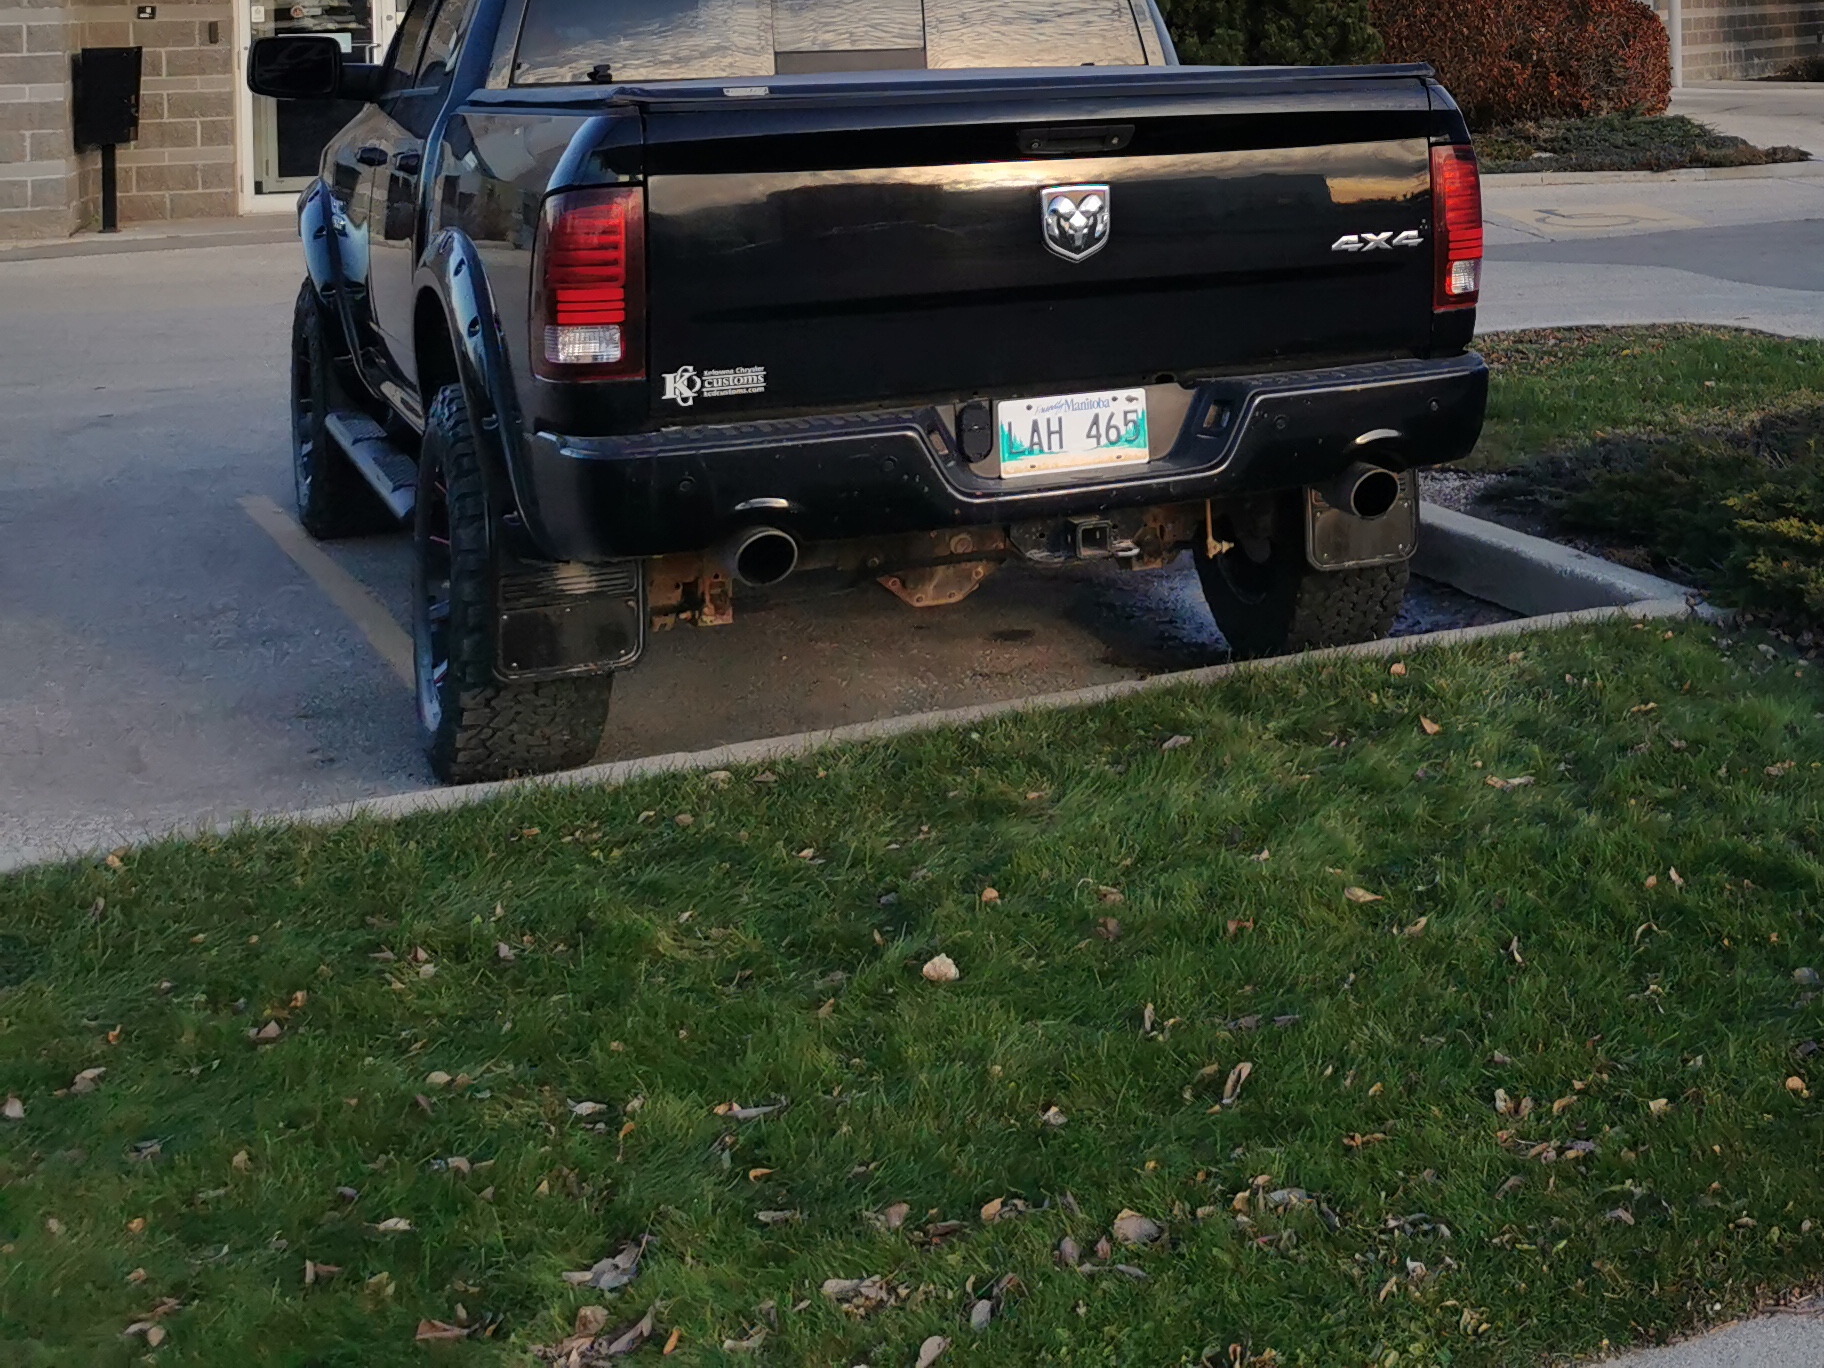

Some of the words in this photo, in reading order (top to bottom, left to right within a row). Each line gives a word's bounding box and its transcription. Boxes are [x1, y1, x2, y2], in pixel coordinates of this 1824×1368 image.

[736, 365, 765, 374] Chrysler
[704, 374, 764, 387] customs
[1065, 397, 1111, 412] Manitoba
[1008, 416, 1063, 454] LAH
[1086, 409, 1141, 447] 465
